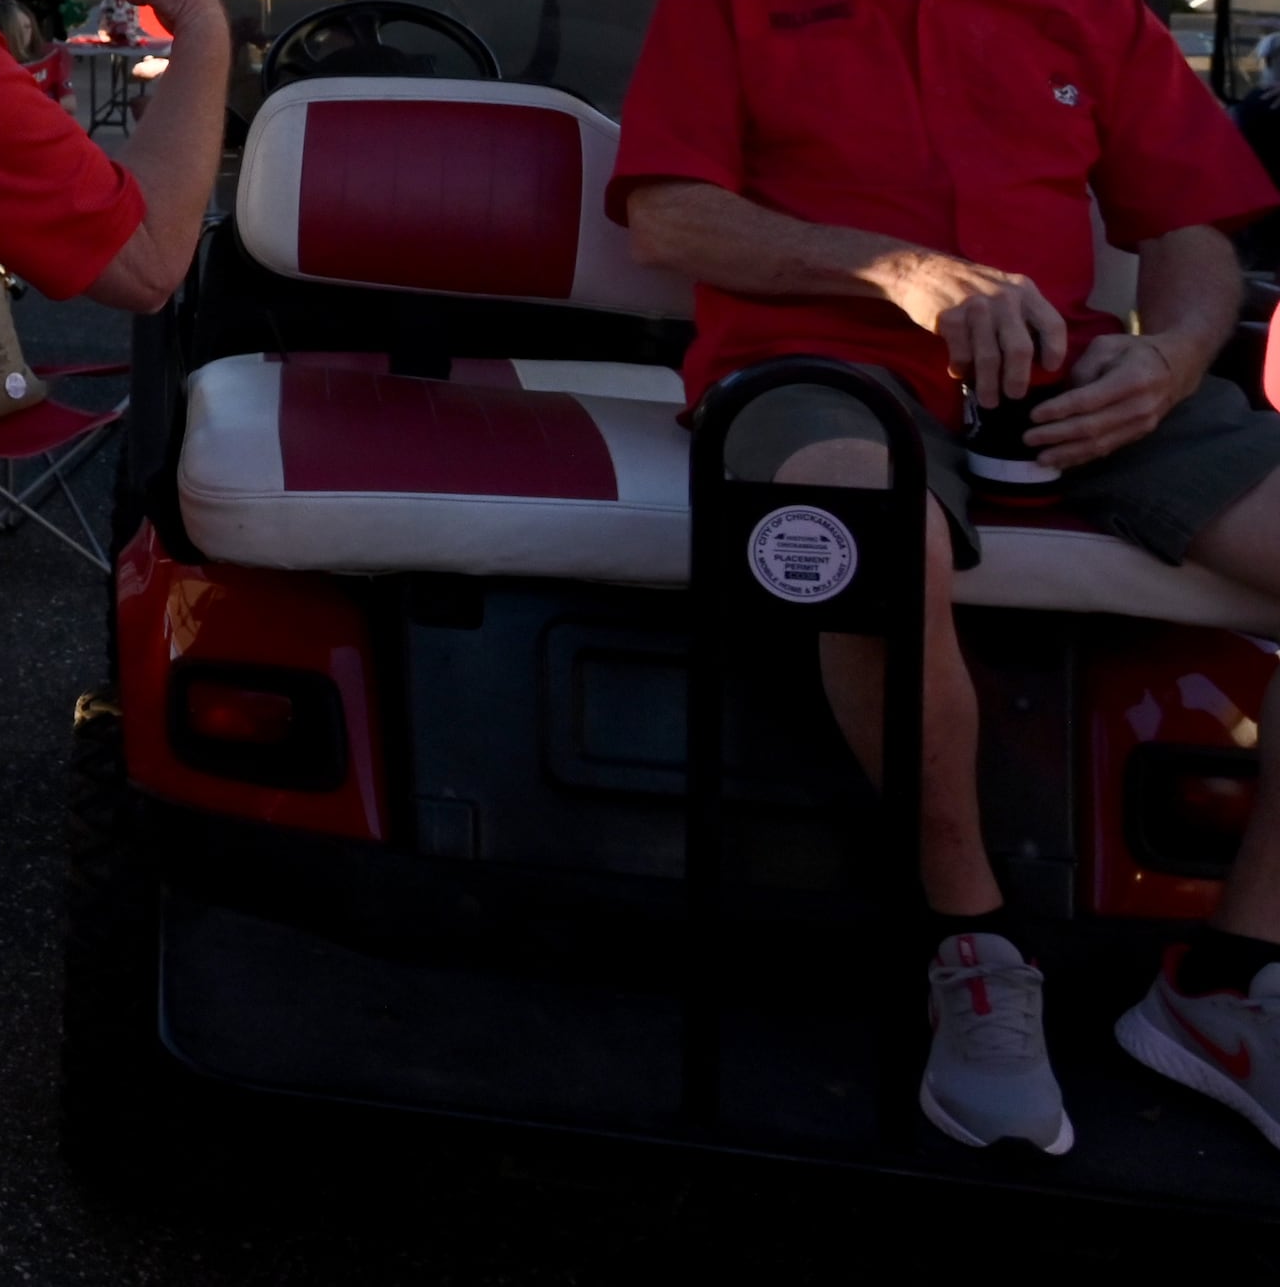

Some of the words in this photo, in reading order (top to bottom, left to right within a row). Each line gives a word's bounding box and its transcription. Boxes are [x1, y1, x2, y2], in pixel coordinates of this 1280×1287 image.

[759, 527, 772, 546] CITY
[771, 517, 783, 529] OF
[785, 513, 846, 550] CHICKAMAUGA
[773, 553, 830, 564] PLACEMENT
[784, 562, 819, 571] PERMIT
[758, 557, 778, 583] MOBILE
[778, 582, 802, 593] HOME
